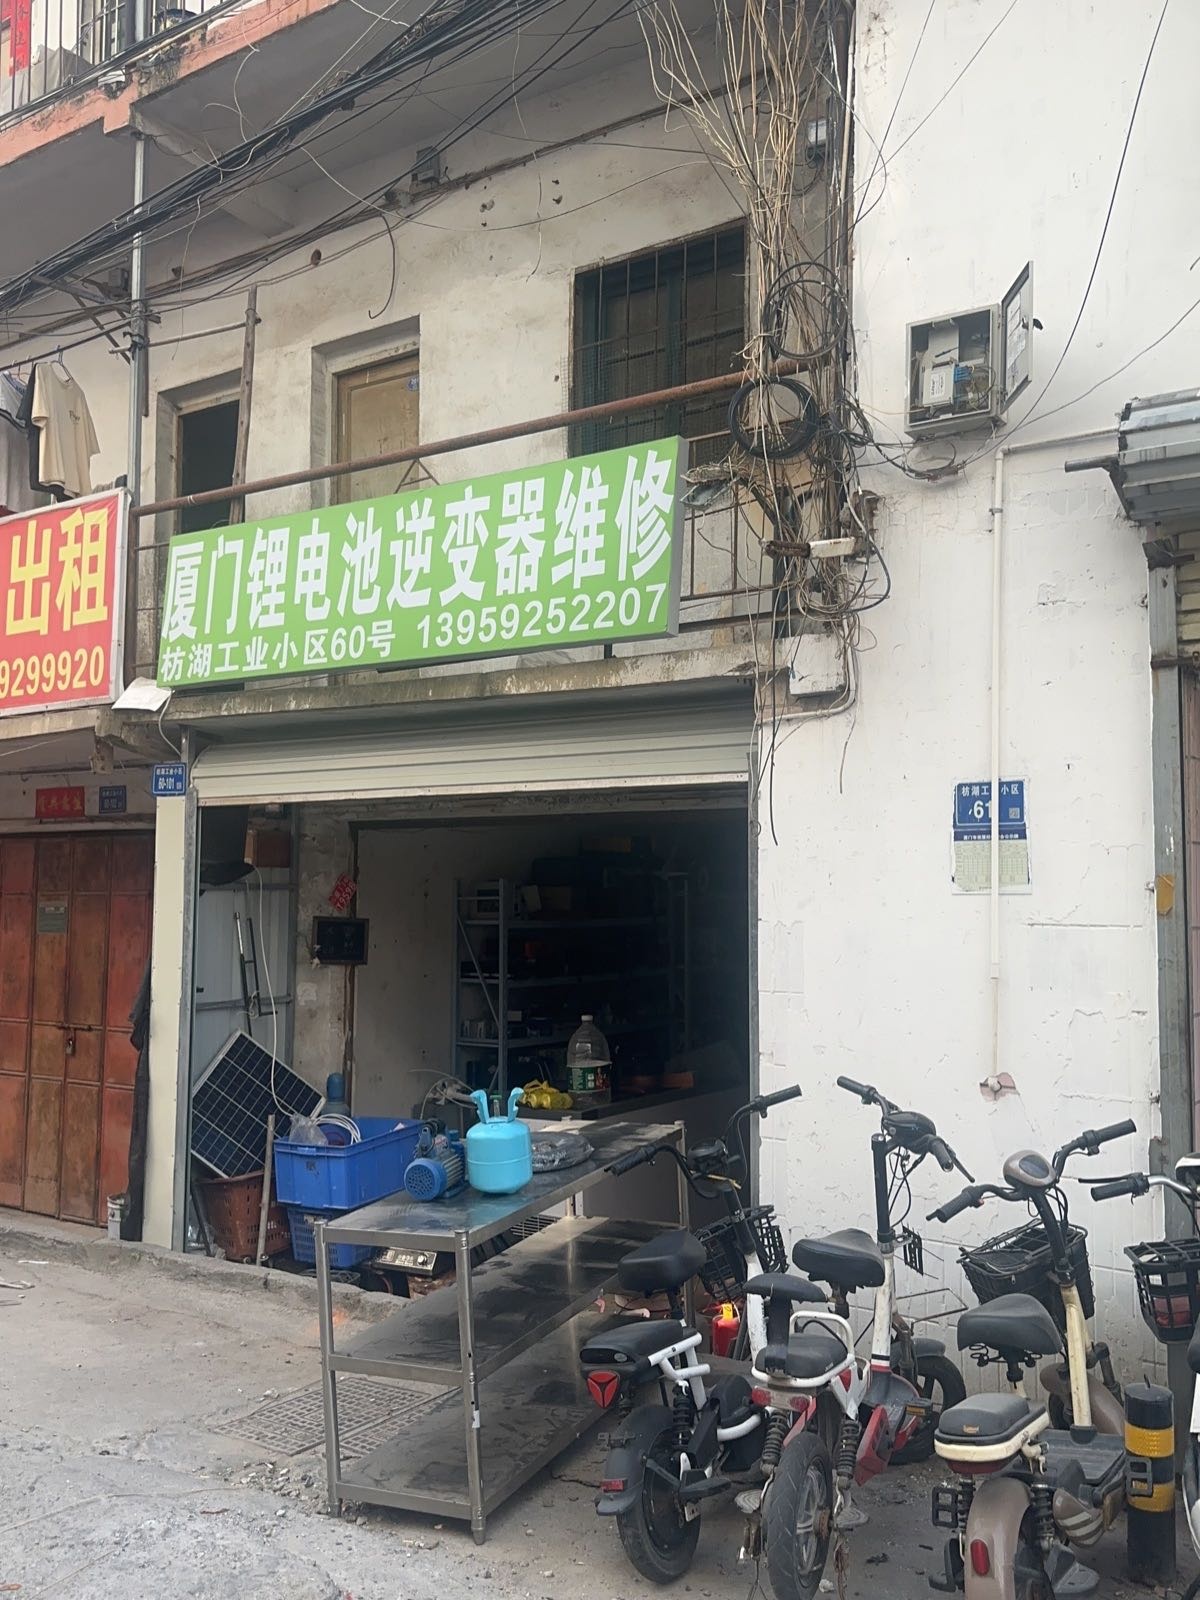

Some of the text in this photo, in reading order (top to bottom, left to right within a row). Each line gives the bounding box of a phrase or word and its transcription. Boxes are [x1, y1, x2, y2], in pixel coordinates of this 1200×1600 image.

[6, 507, 109, 636] 出租
[162, 450, 674, 643] 厦门锂电池逆变器维修
[0, 646, 104, 699] 9299920
[161, 583, 667, 682] 枋湖工业小区60号 13959252207
[962, 784, 1019, 797] 枋湖工小区
